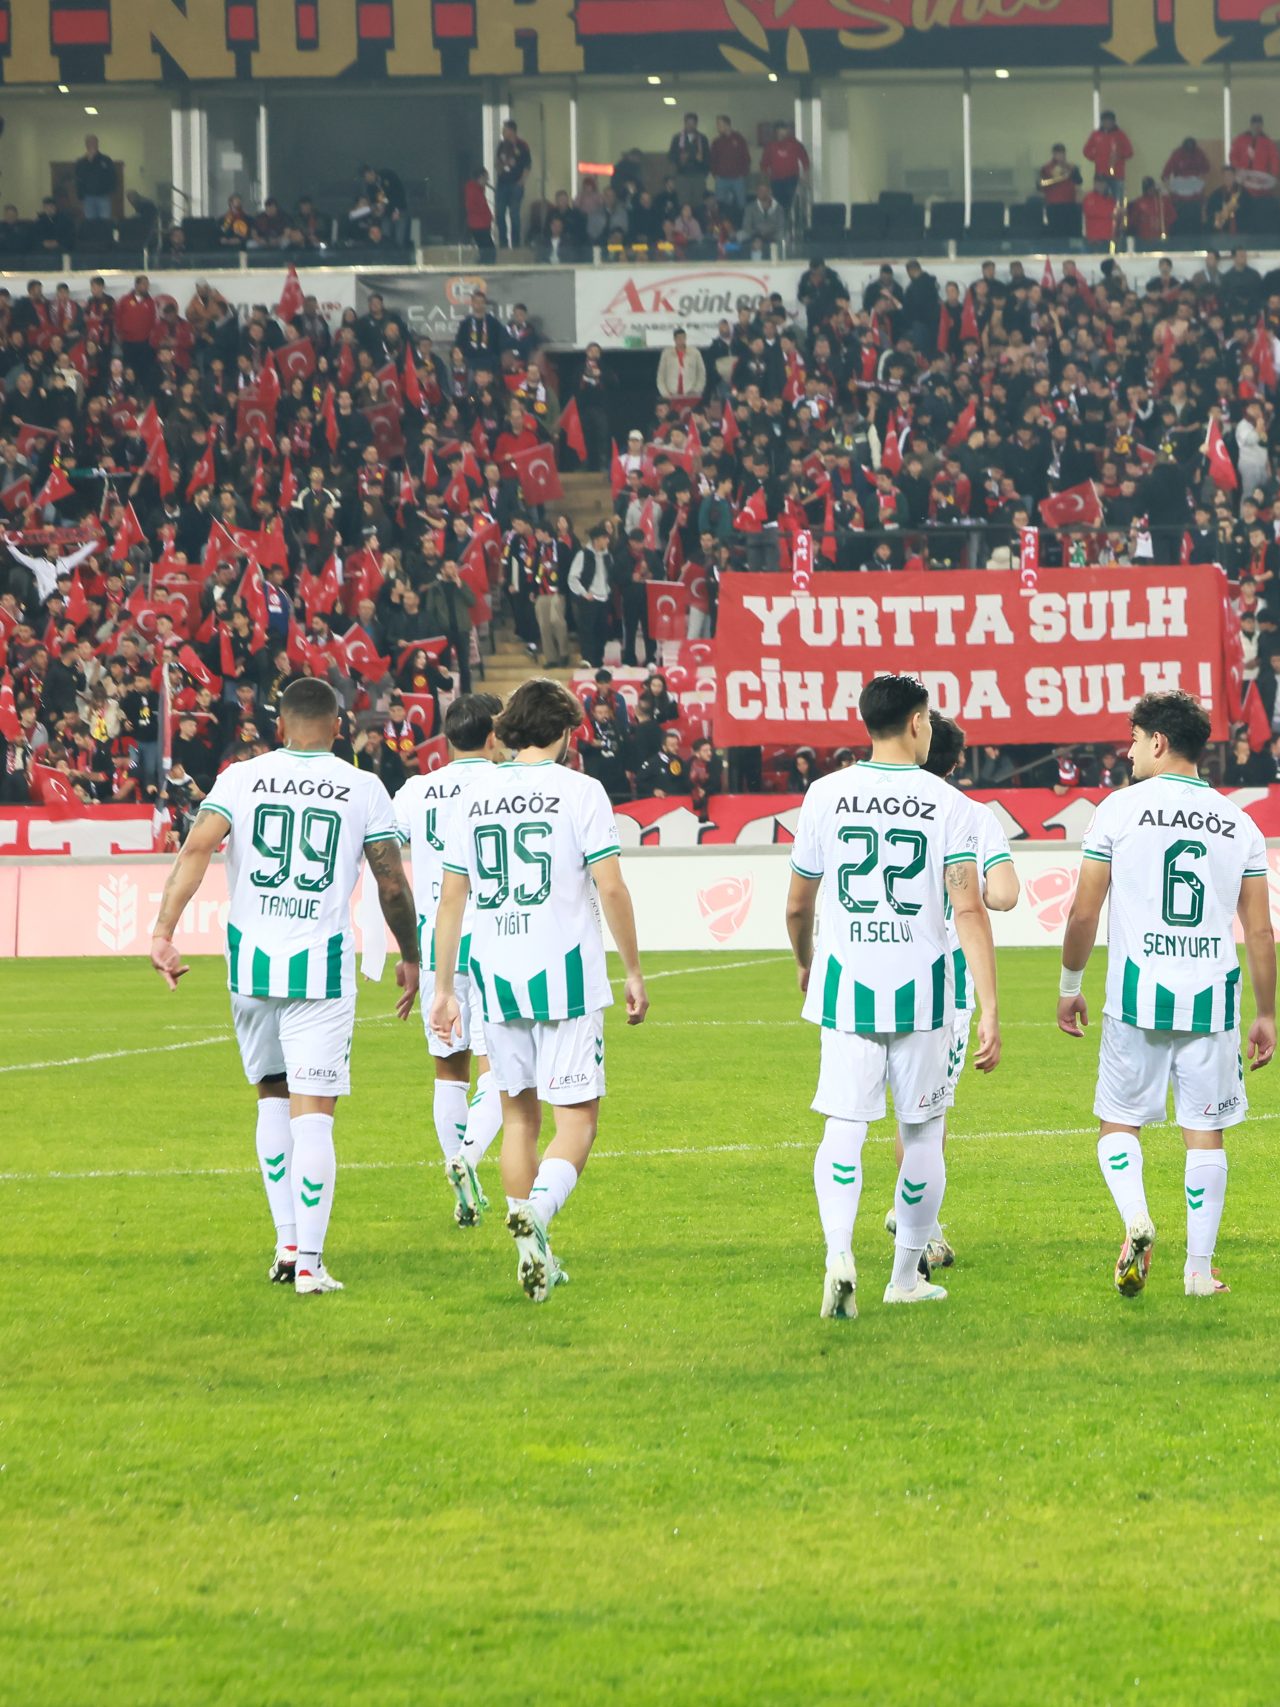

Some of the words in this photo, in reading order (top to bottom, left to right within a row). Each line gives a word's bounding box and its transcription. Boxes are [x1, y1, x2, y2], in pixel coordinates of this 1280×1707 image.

[743, 594, 1014, 646] YURTTA
[1029, 587, 1188, 643] SULH
[726, 658, 1011, 721] CİHADA
[252, 777, 351, 803] ALAGÖZ
[424, 784, 462, 800] ALA
[468, 792, 560, 818] ALAGÖZ
[835, 795, 937, 821] ALAGÖZ
[1138, 809, 1236, 839] ALAGÖZ
[249, 802, 342, 893] 99
[473, 821, 553, 910] 95
[837, 825, 928, 916] 22
[1161, 838, 1208, 928] 6
[259, 894, 321, 921] TANQUE
[495, 911, 531, 937] YİĞİT
[1143, 932, 1222, 959] ŞENYURT
[308, 1067, 338, 1078] DELTA
[559, 1073, 588, 1085] DELTA
